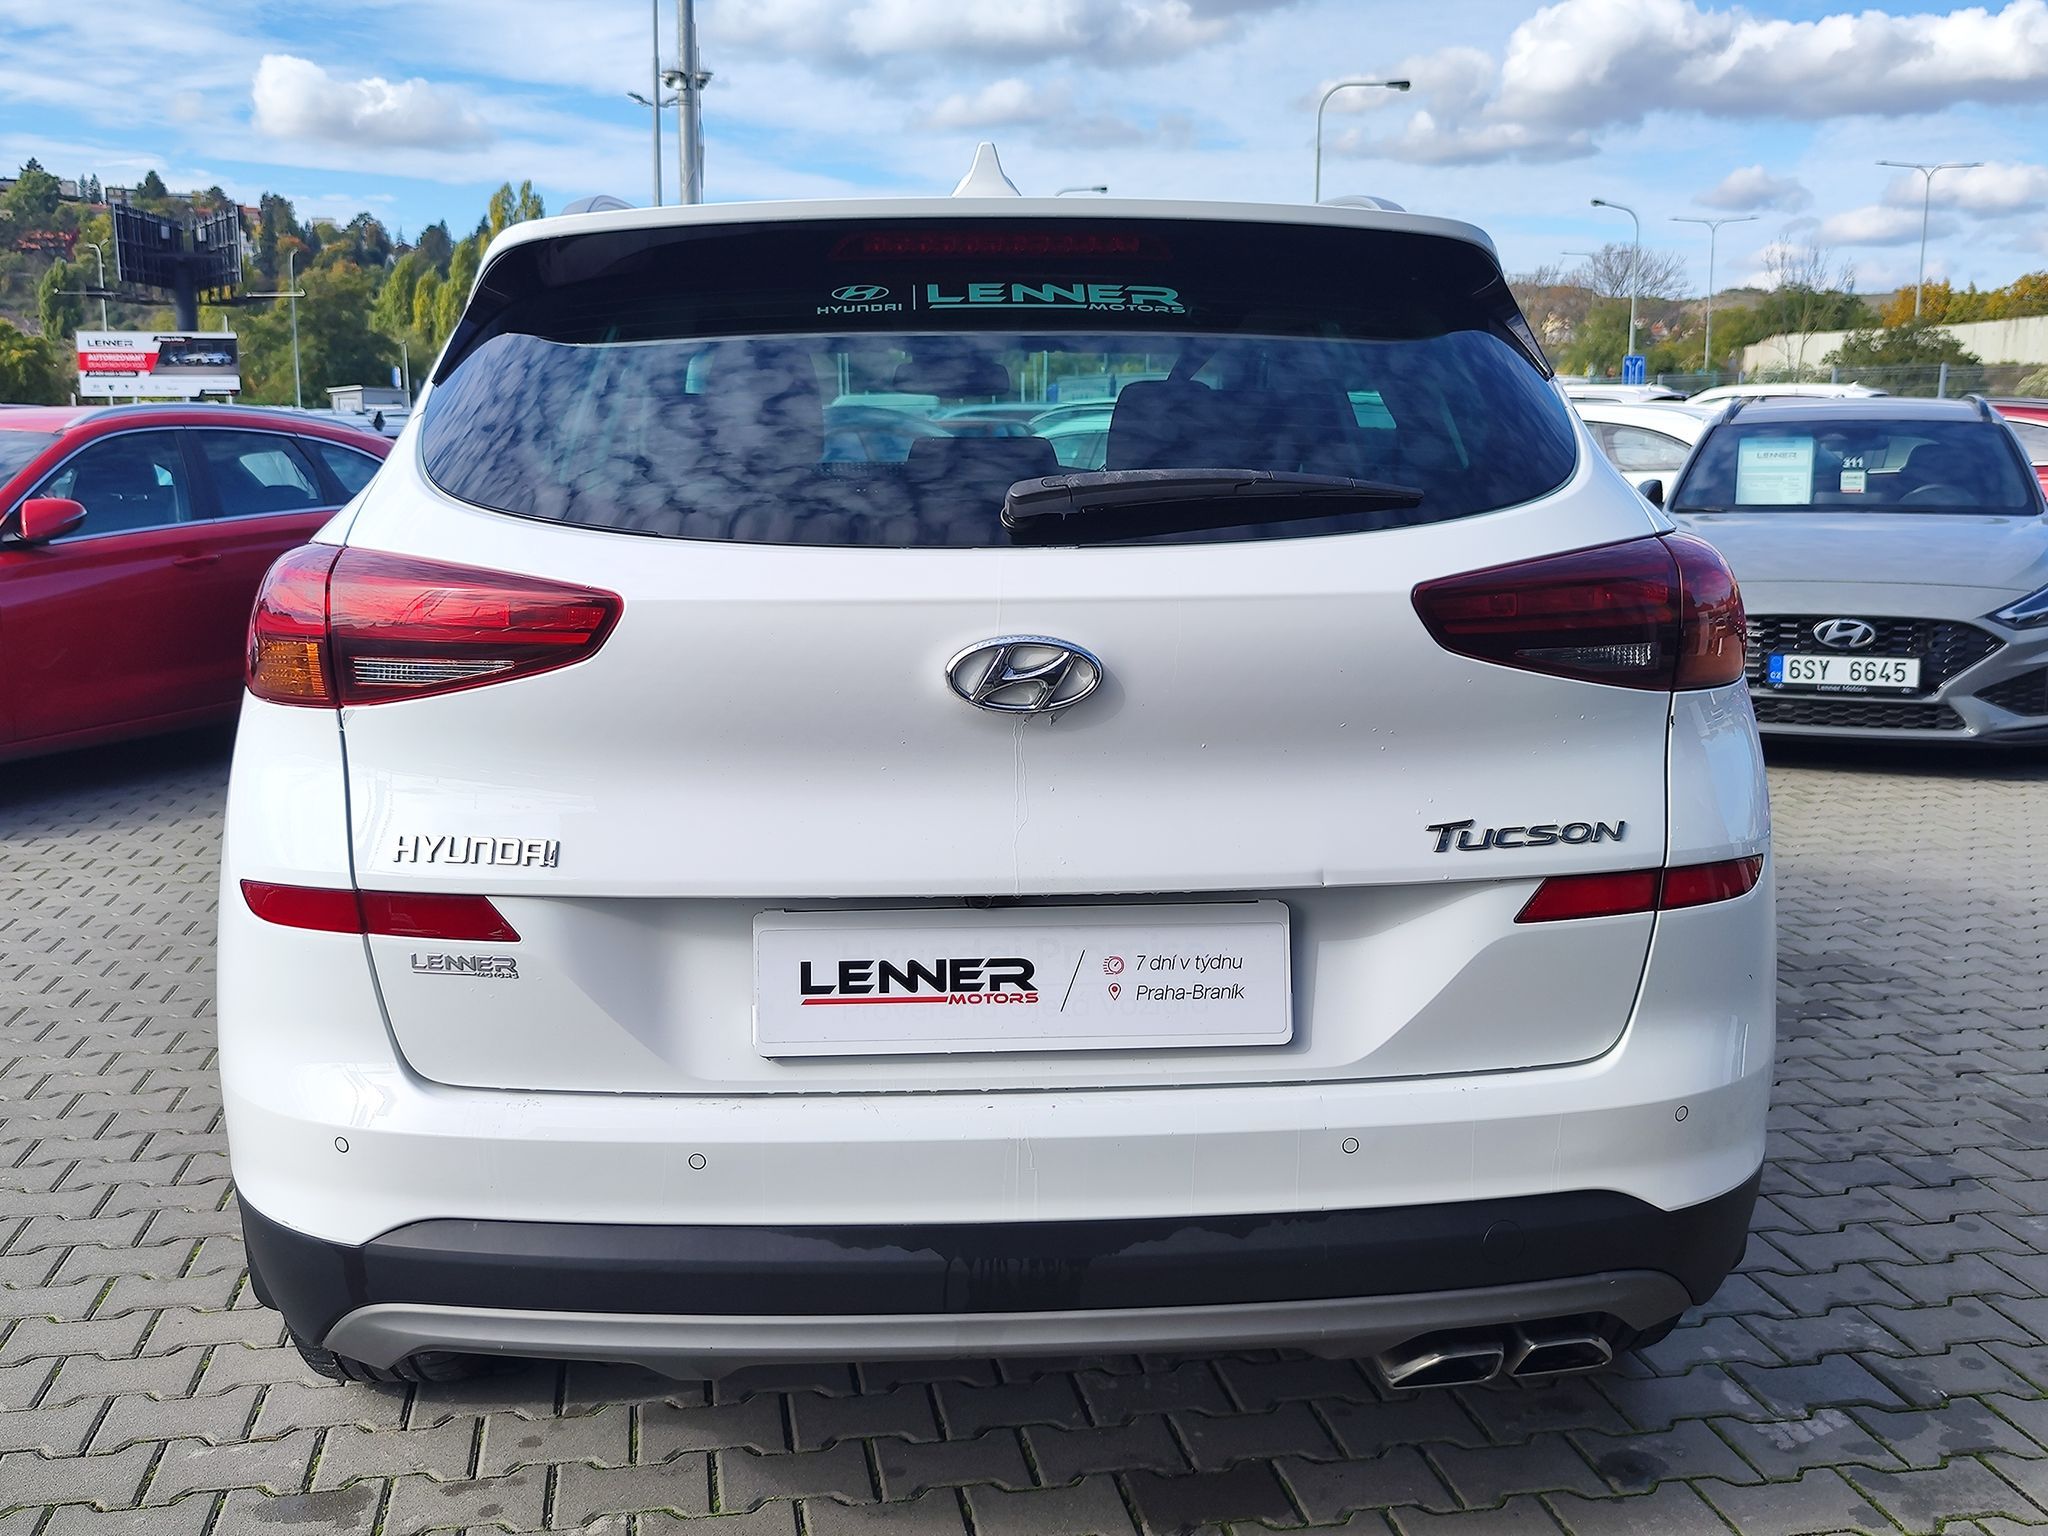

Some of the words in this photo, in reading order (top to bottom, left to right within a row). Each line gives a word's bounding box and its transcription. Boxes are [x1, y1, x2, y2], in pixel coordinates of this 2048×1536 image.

[927, 283, 1184, 306] LENNER
[816, 303, 903, 315] HYUNDAI
[1088, 303, 1186, 314] MOTORS
[87, 339, 135, 348] LENNER
[1842, 456, 1864, 468] 311
[1789, 659, 1830, 680] 6SY
[1850, 661, 1907, 683] 6645
[1816, 684, 1841, 692] Lenner
[1842, 685, 1868, 693] Motors
[1425, 818, 1626, 853] TUCSON
[392, 835, 561, 868] HYUNDAI
[410, 953, 518, 973] LENNER
[1136, 954, 1147, 971] 7
[1149, 954, 1178, 971] dní
[1180, 958, 1191, 970] v
[1195, 953, 1243, 974] týdnu
[474, 971, 520, 980] MOTORS
[799, 957, 1039, 995] LENNER
[947, 991, 1039, 1006] MOTORS
[1136, 983, 1246, 1001] Praha-Braník
